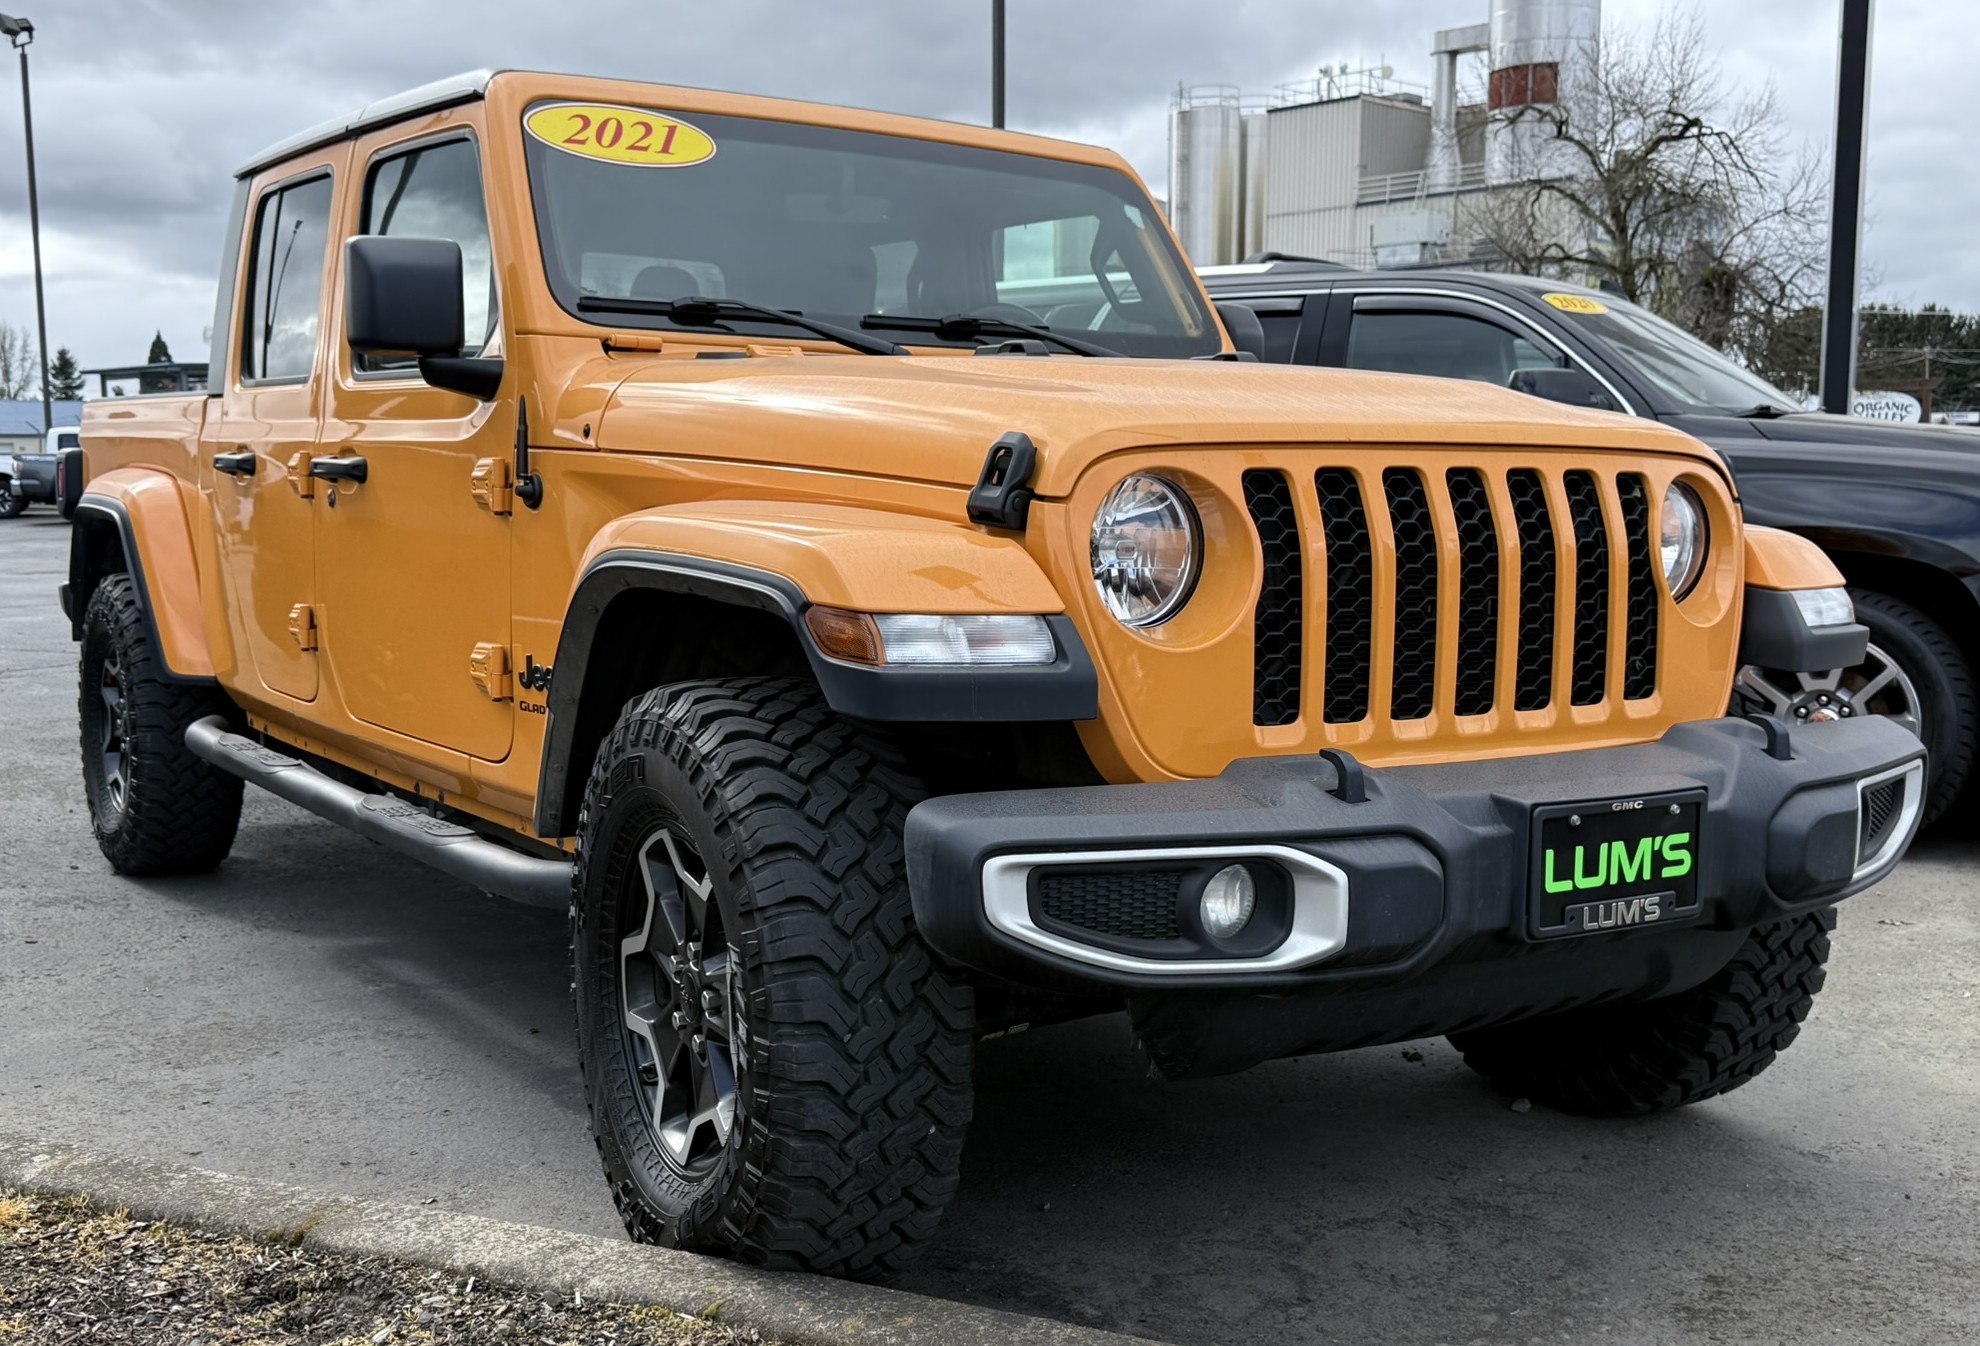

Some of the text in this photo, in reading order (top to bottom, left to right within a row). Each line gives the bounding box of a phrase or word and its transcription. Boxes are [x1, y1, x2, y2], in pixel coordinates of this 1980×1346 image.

[562, 114, 678, 155] 2021
[1853, 401, 1914, 416] ORGANIC
[1611, 800, 1644, 812] GMC
[1544, 832, 1692, 893] LUM'S
[1583, 896, 1661, 931] LUM'S
